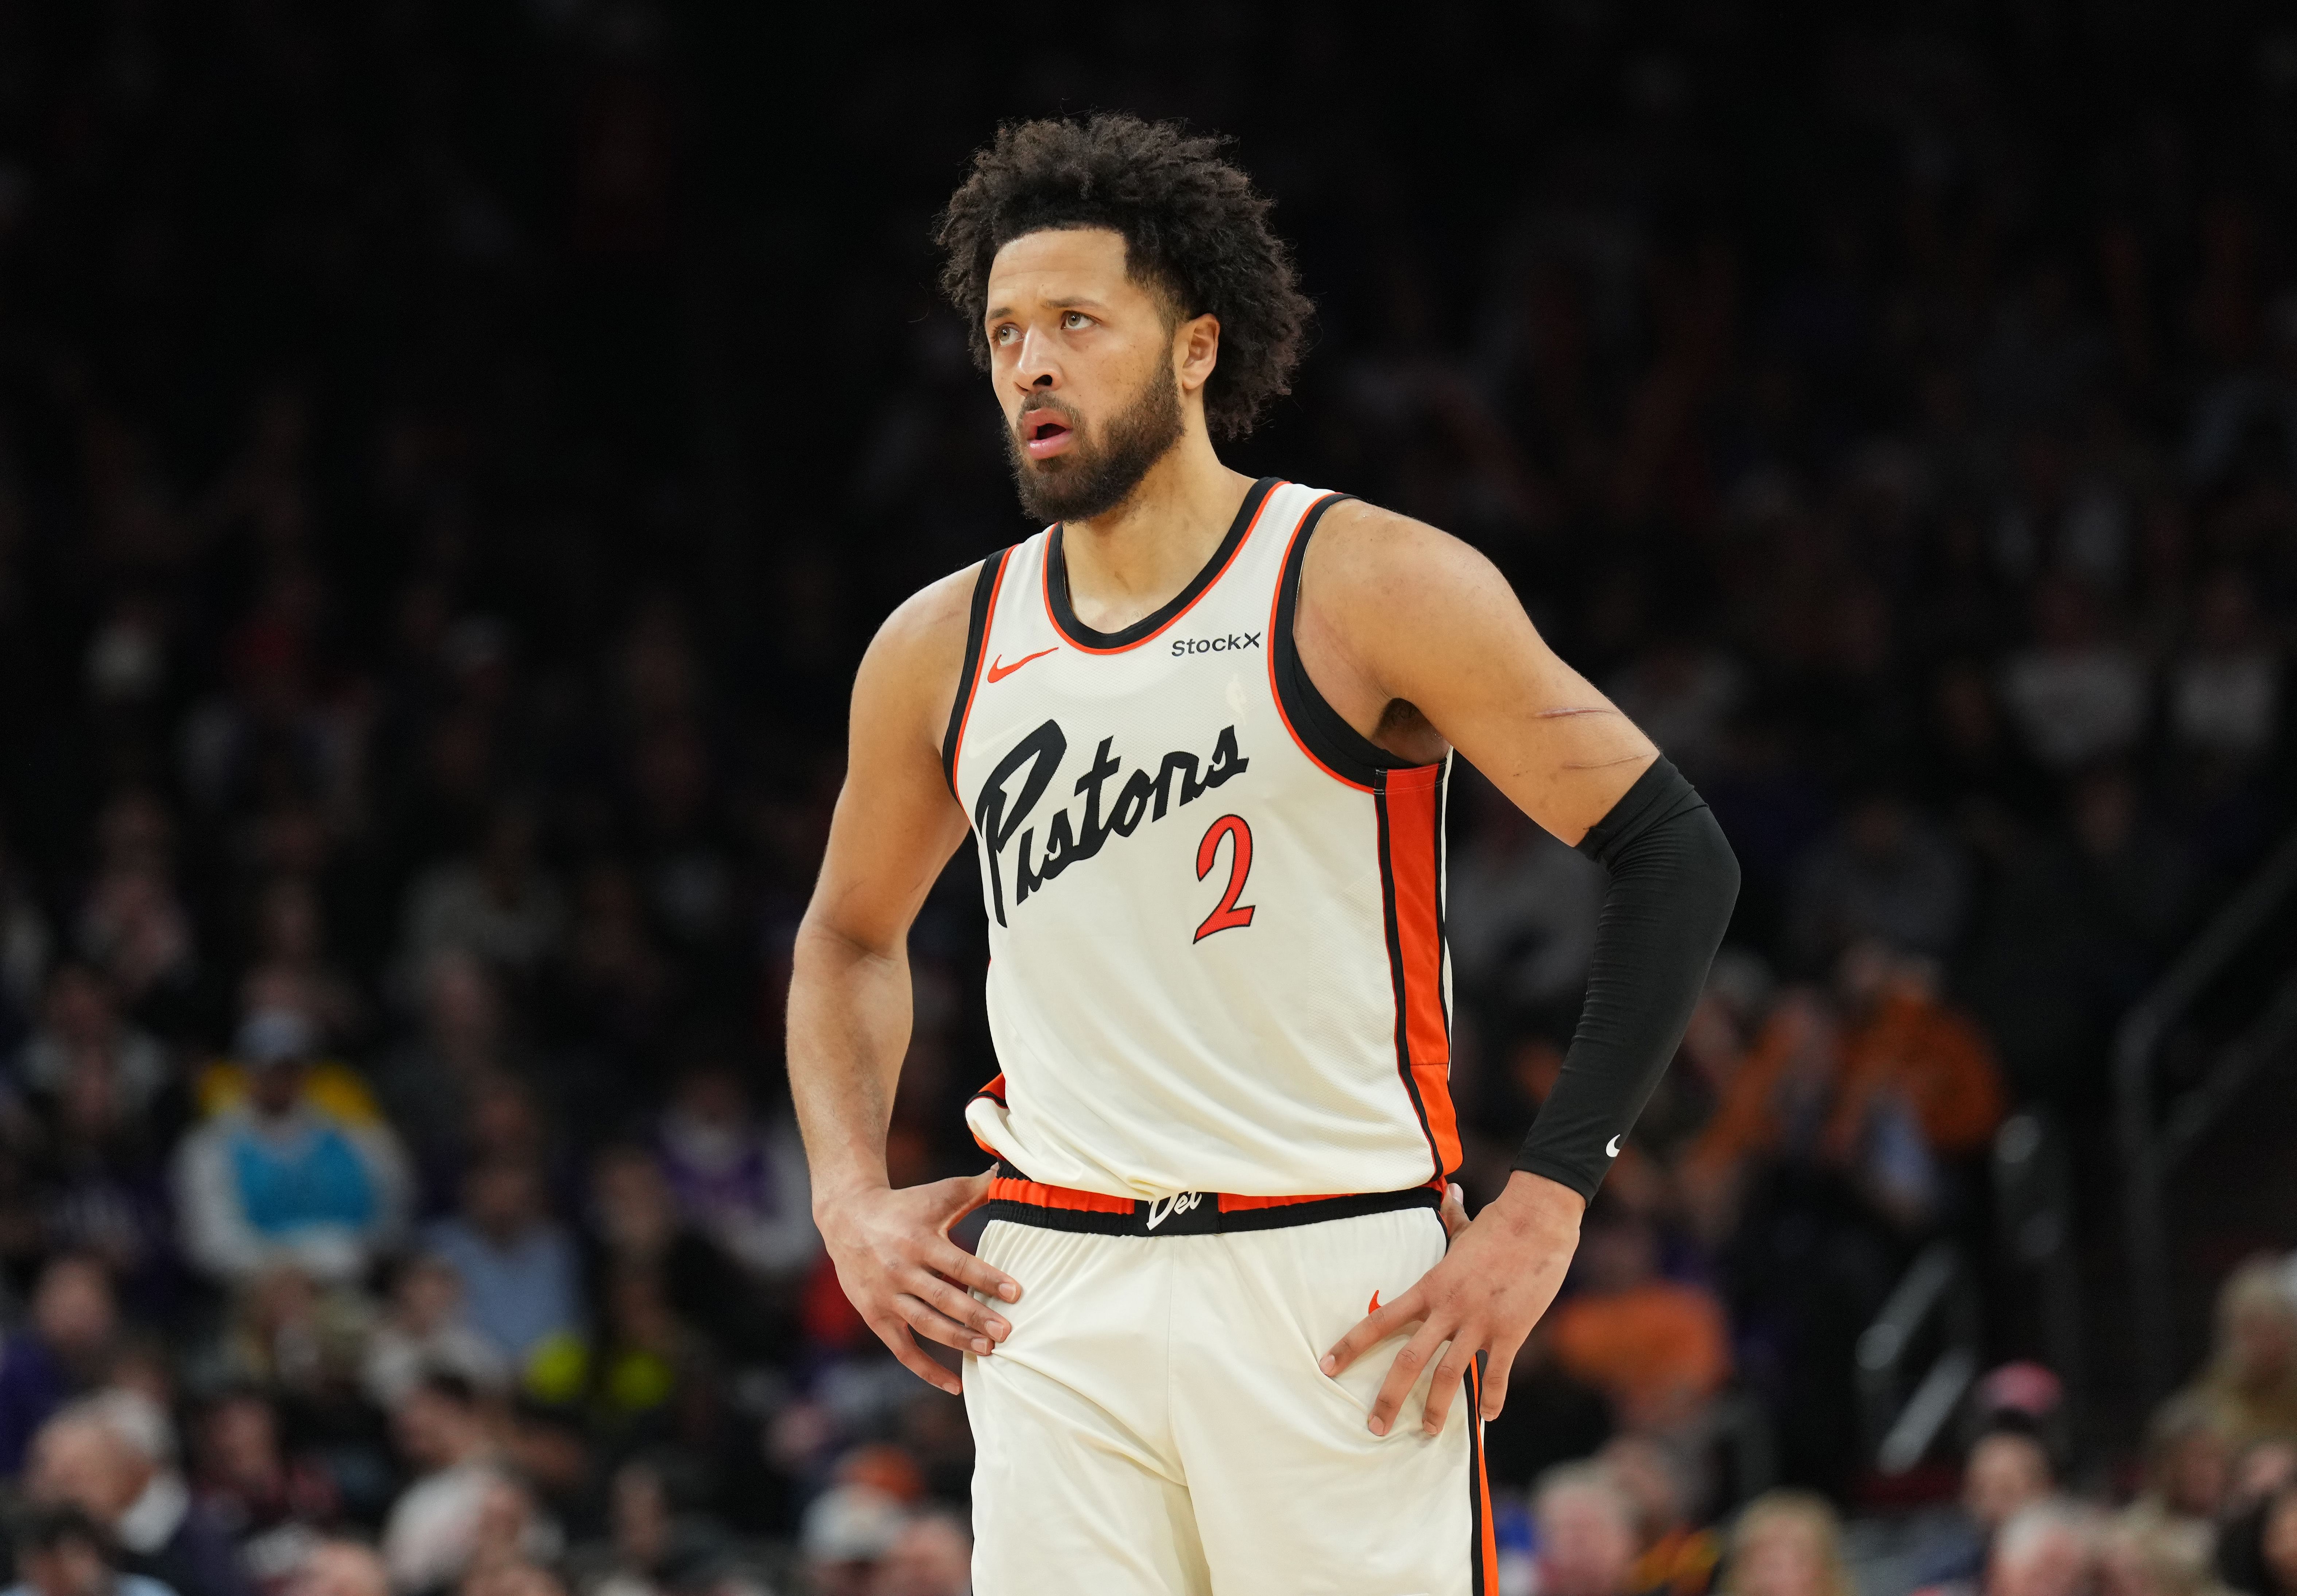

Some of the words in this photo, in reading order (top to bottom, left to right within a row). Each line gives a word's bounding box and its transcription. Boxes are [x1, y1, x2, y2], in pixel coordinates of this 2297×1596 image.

[1171, 632, 1260, 656] StockX
[975, 718, 1250, 928] Pistons
[1193, 814, 1256, 945] 2
